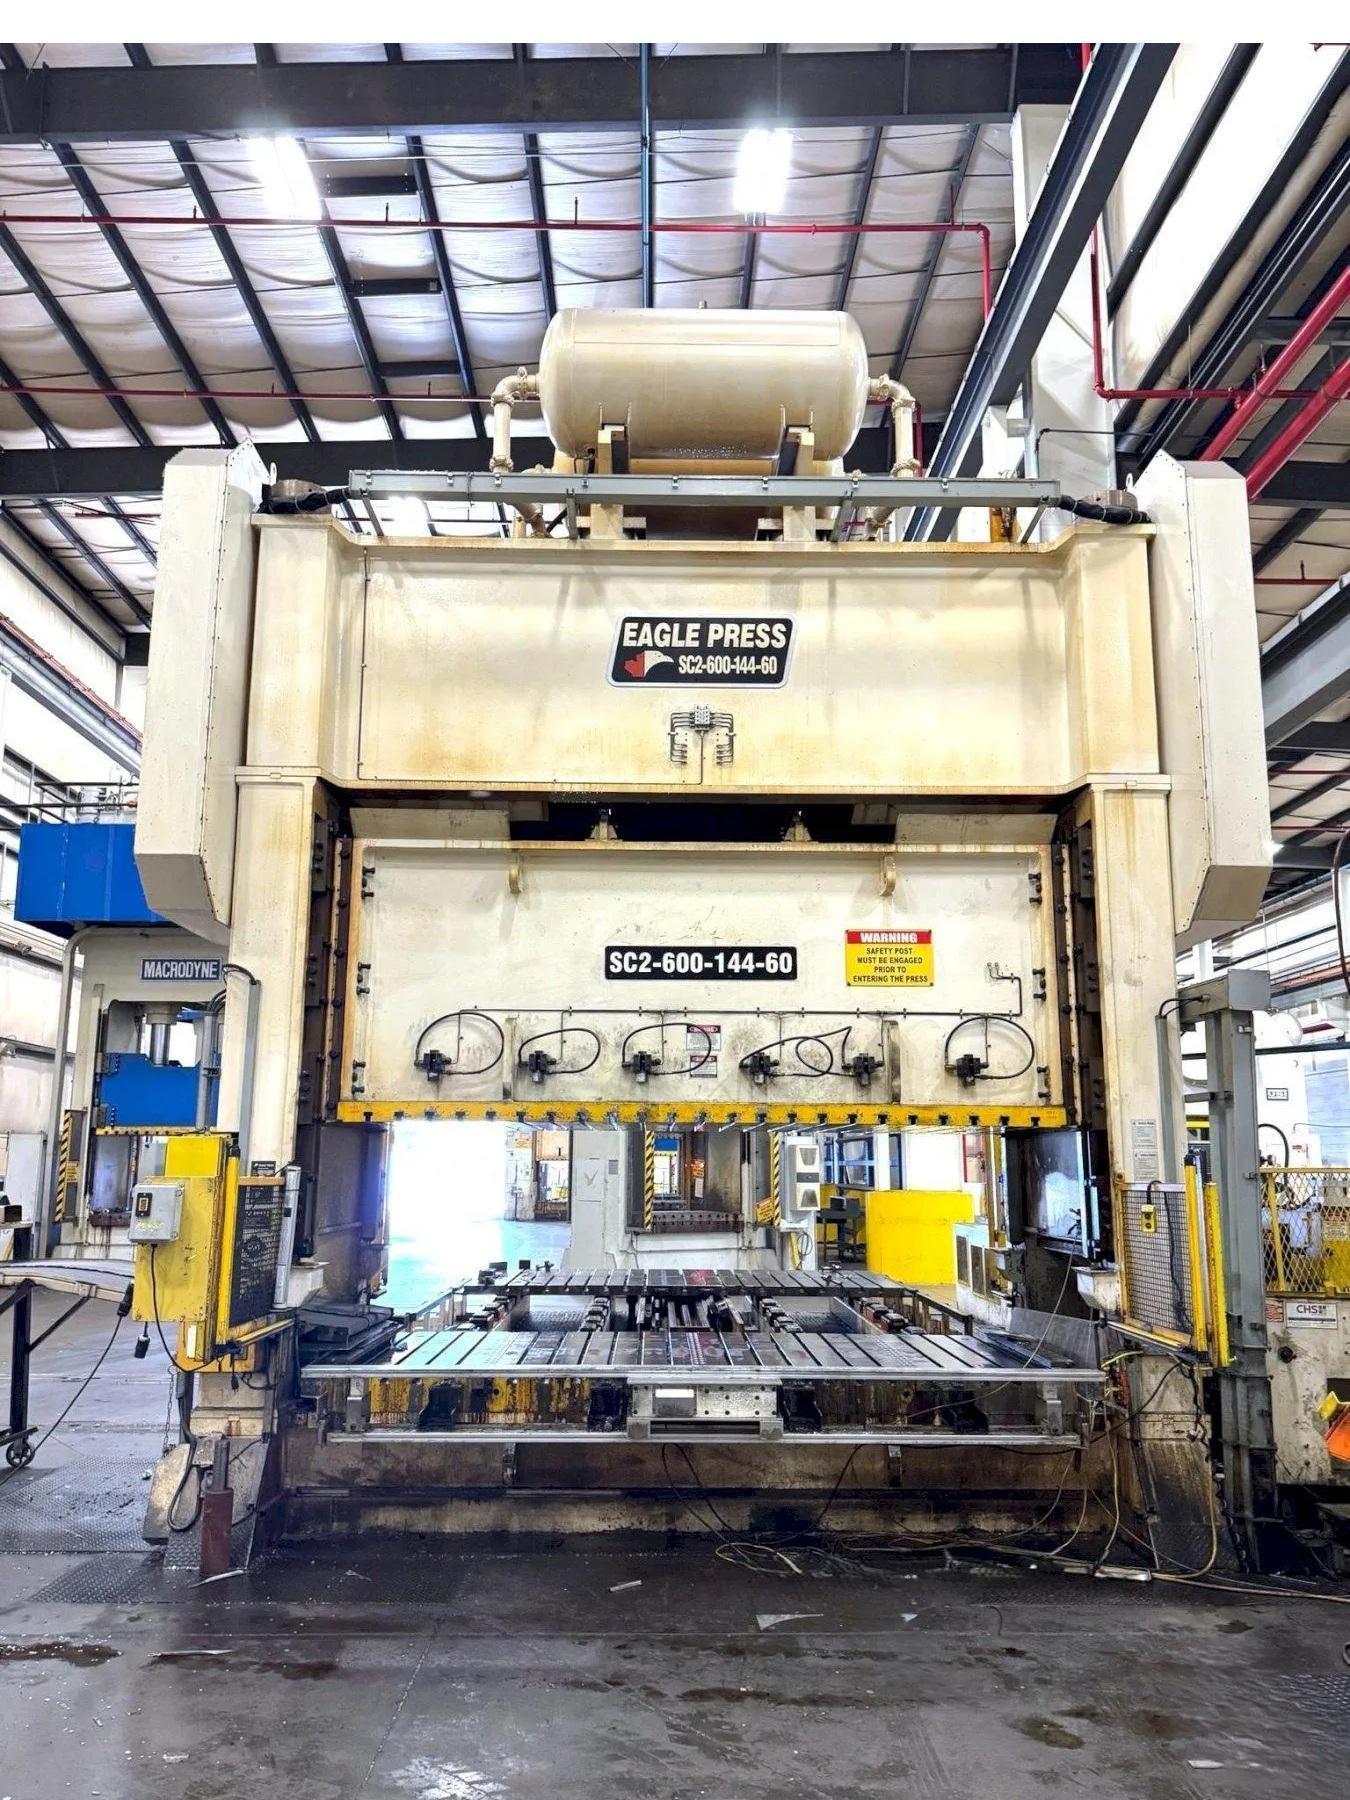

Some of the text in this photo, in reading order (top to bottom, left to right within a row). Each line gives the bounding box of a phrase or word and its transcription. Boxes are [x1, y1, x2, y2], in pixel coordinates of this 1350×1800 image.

[623, 622, 787, 648] EAGLE PRESS
[678, 655, 778, 675] SC2-600-144-60
[860, 932, 918, 943] WARNING
[866, 947, 913, 955] SAFETY POST
[144, 961, 218, 978] MACRODYNE
[609, 951, 794, 974] SC2-600-144-60
[853, 975, 928, 983] ENTERING THE PRESS
[1296, 1304, 1318, 1314] CHS
